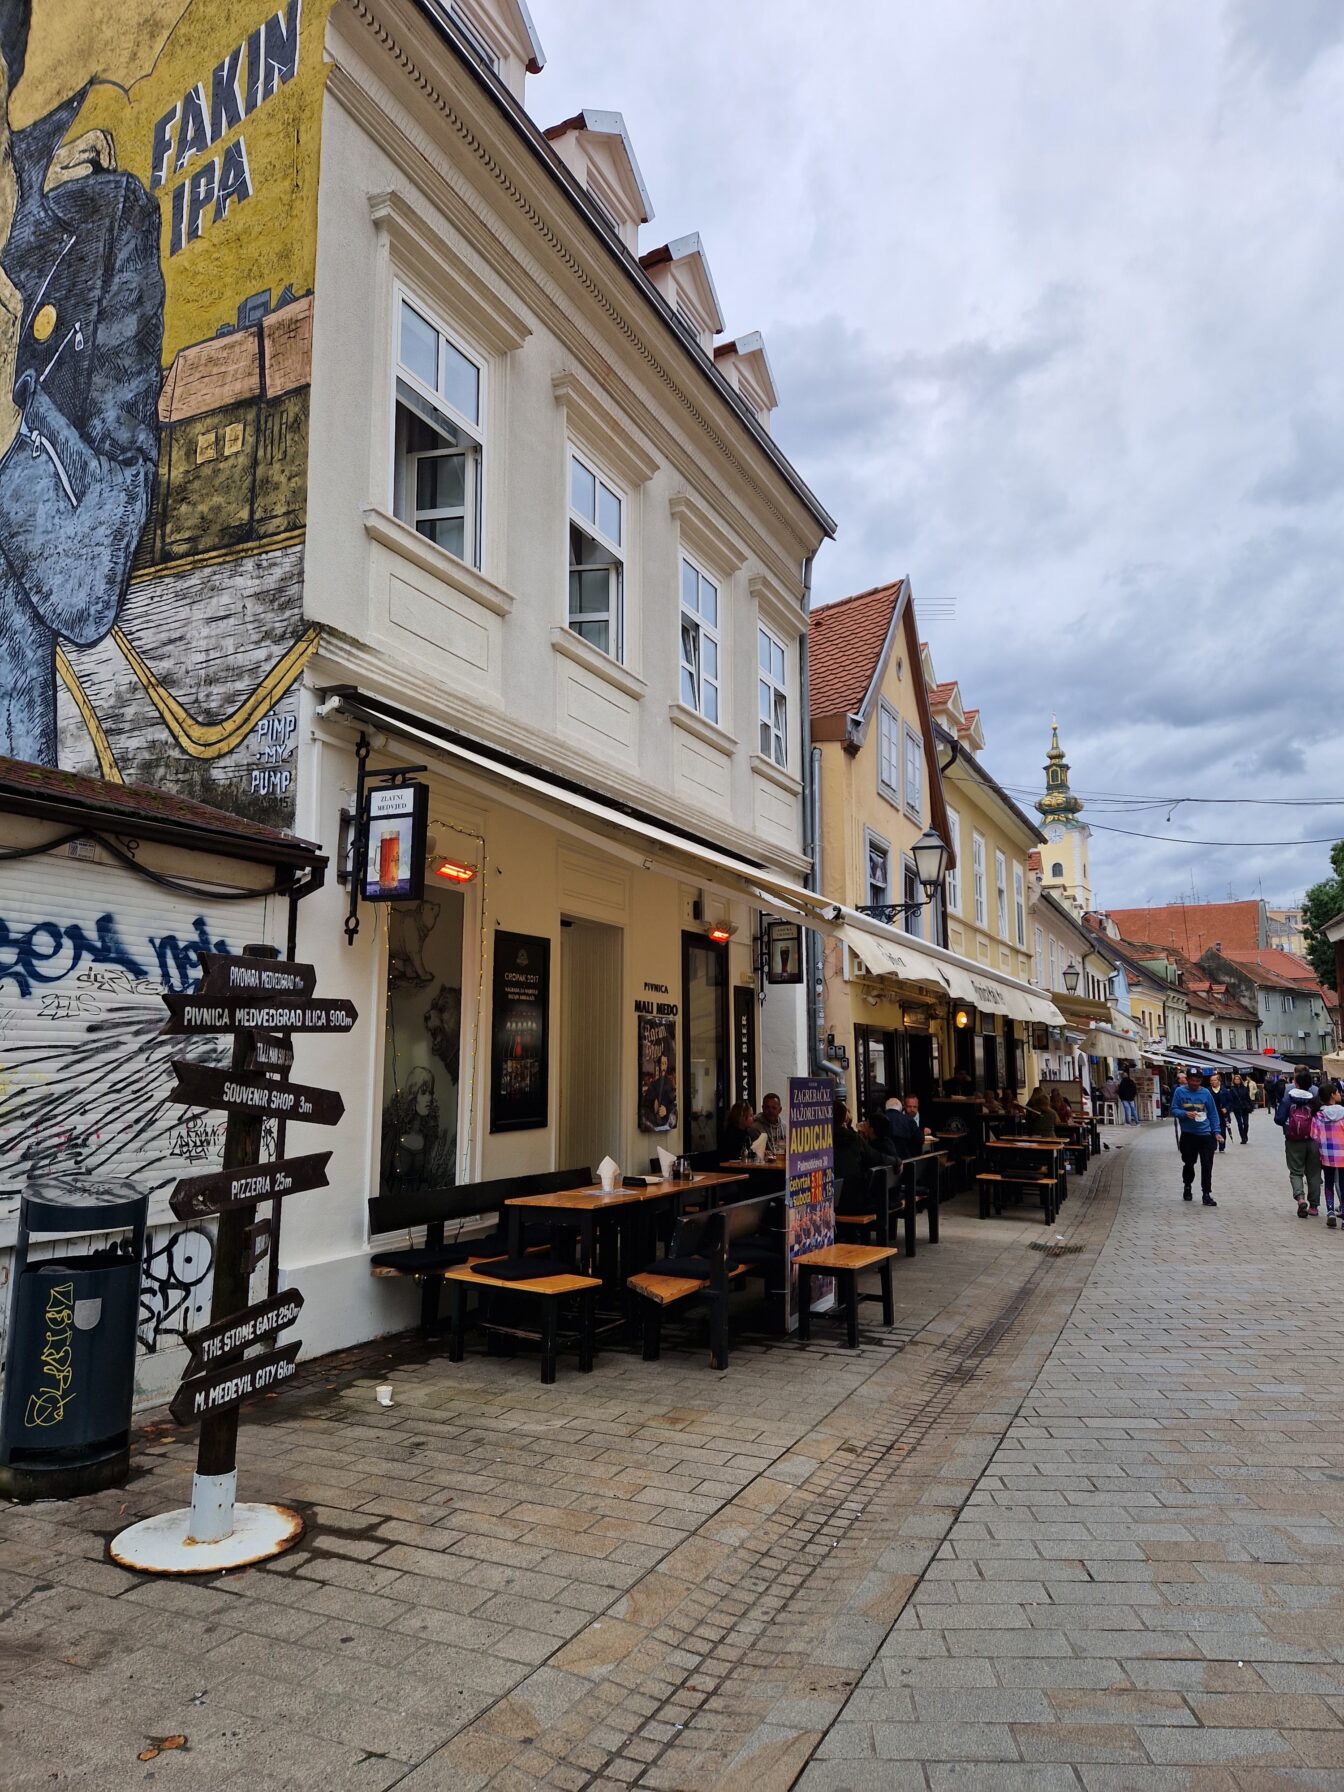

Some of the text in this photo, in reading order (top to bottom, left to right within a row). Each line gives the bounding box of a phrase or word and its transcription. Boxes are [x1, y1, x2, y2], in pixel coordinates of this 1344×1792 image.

[150, 0, 302, 194] FAKIN
[170, 135, 253, 258] IPA
[257, 715, 297, 744] PIMP
[265, 744, 287, 765] MY
[251, 770, 292, 796] PUMP
[230, 966, 259, 988] PIVOVARA
[261, 971, 294, 989] MEDVEDGRAD
[643, 982, 669, 994] PIVNICA
[184, 1007, 353, 1027] PIVNICA MEDVEDGRAD ILICA 900m
[634, 1000, 678, 1016] MALI MEDO
[223, 1082, 312, 1113] SOUVENIR SHOP 3m
[794, 1086, 831, 1103] ZAGREBAČKE
[790, 1124, 832, 1154] AUDICIJA
[231, 1172, 292, 1200] PIZZERIA 25m
[203, 1302, 300, 1362] THE STONE GATE 250m
[194, 1360, 295, 1413] M. MEDEVIL CITY 6km
